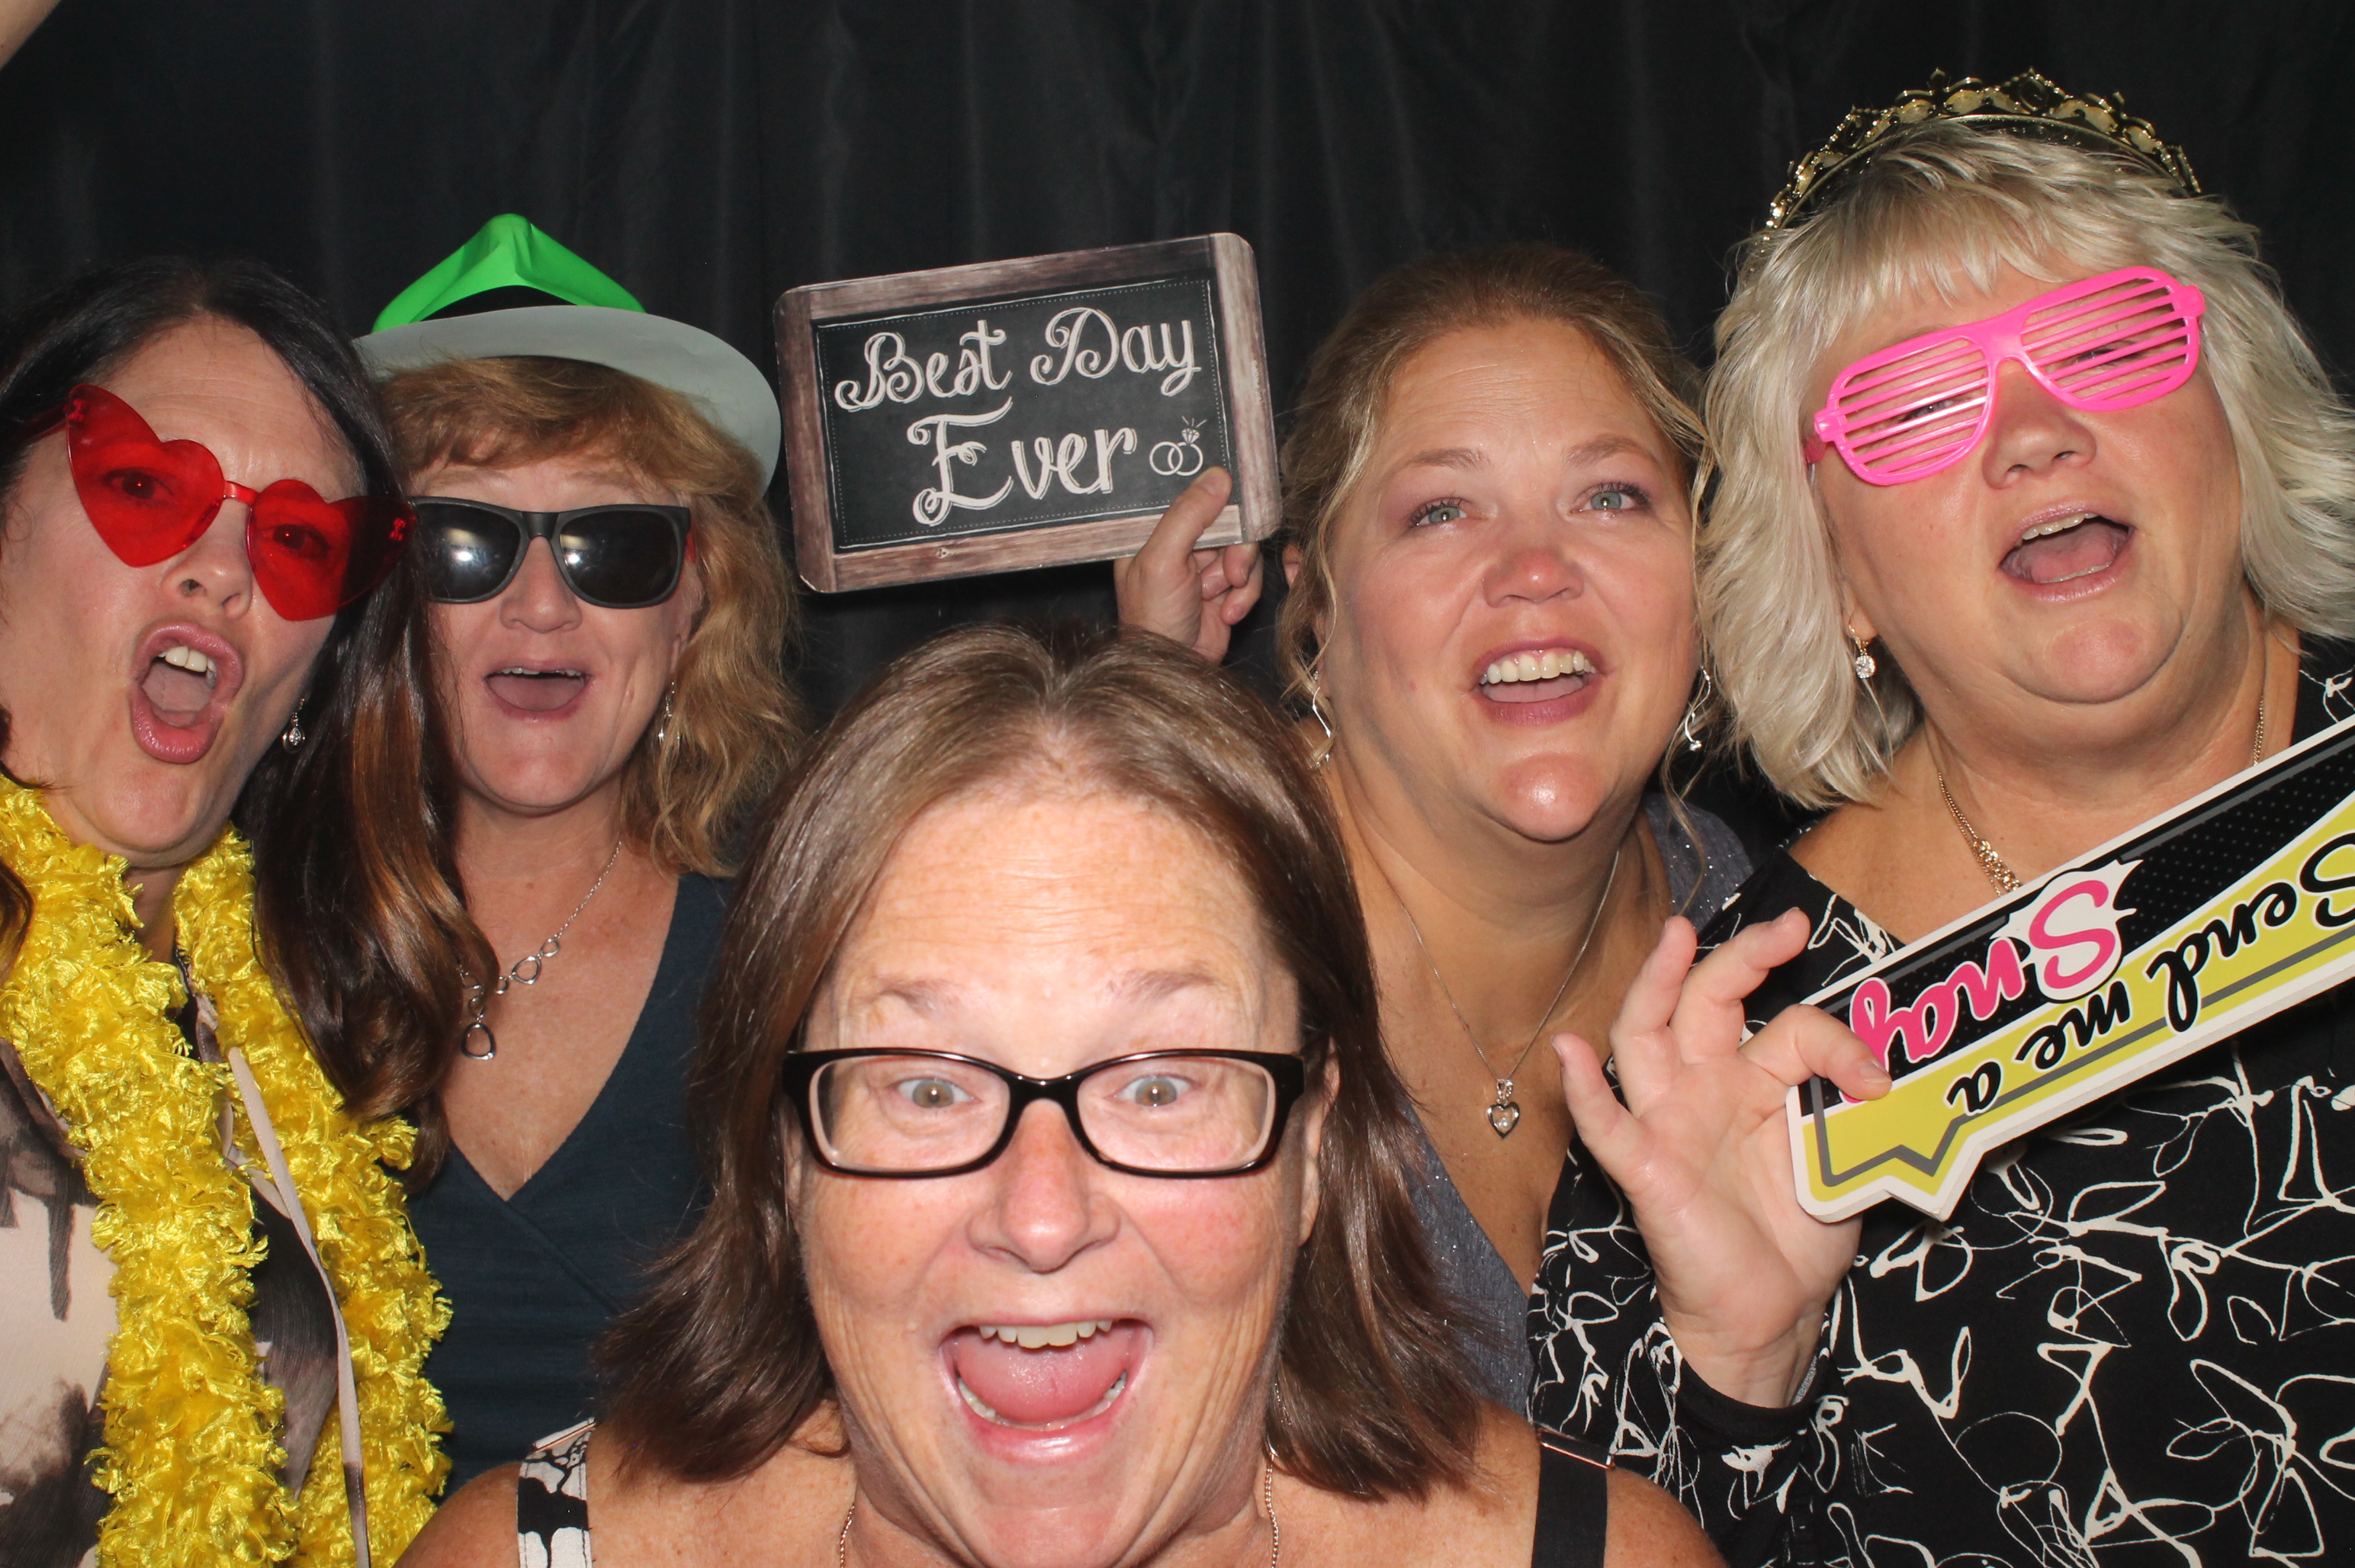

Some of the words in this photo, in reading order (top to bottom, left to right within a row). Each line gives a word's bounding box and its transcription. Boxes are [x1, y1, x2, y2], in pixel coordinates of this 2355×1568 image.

[834, 318, 1014, 413] Best
[1030, 307, 1203, 398] Day
[906, 396, 1139, 528] Ever
[2145, 832, 2355, 1033] Send
[2016, 981, 2130, 1069] me
[1946, 1062, 2001, 1113] a
